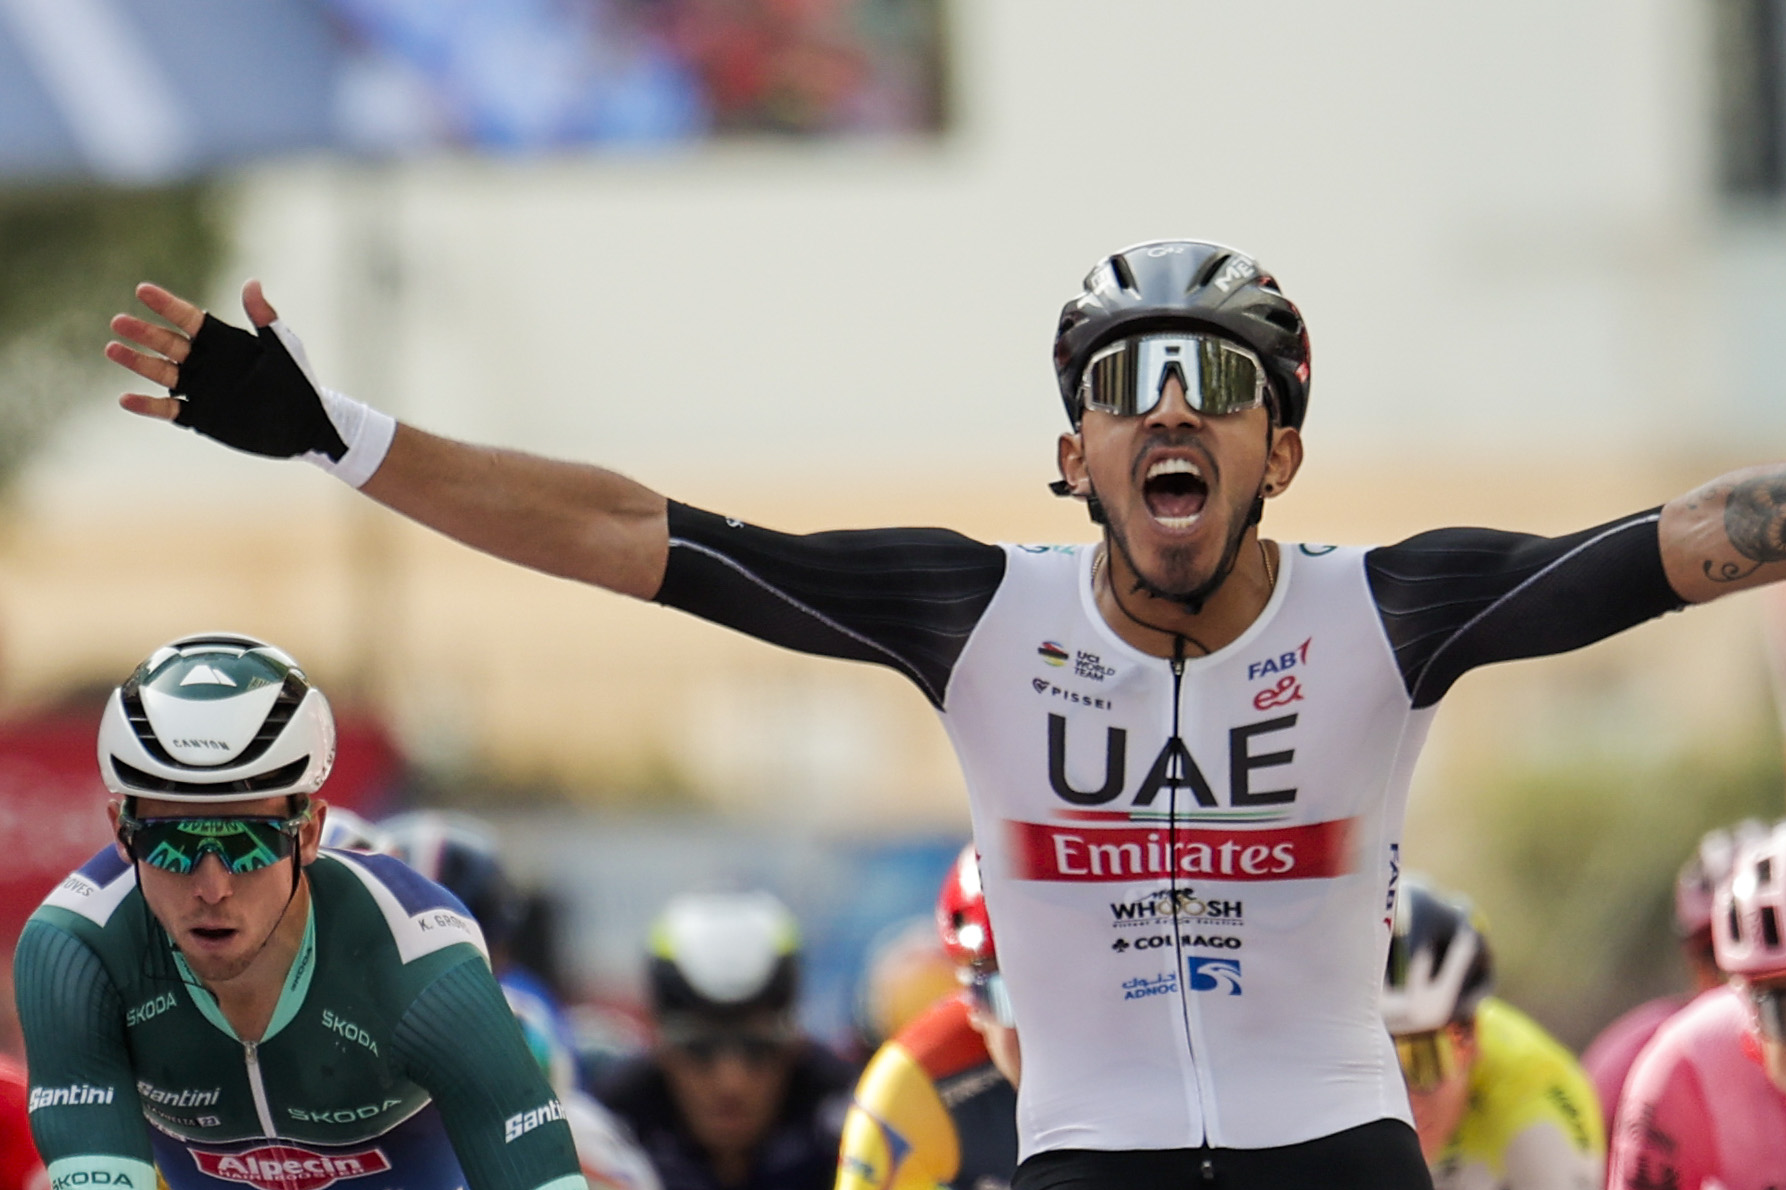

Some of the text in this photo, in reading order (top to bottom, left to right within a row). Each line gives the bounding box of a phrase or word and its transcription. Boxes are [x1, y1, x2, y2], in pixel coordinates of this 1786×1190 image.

[1077, 650, 1100, 663] UCI
[1074, 667, 1104, 683] TEAM
[1075, 661, 1116, 677] WORLD
[1052, 686, 1112, 711] PISSEI
[172, 738, 231, 752] CANYON
[1047, 712, 1299, 807] UAE
[1051, 833, 1296, 876] Emirates
[61, 874, 94, 898] OVES
[1109, 900, 1243, 920] WHOOSH
[28, 1083, 115, 1114] Santini
[217, 1153, 362, 1182] Alpecin
